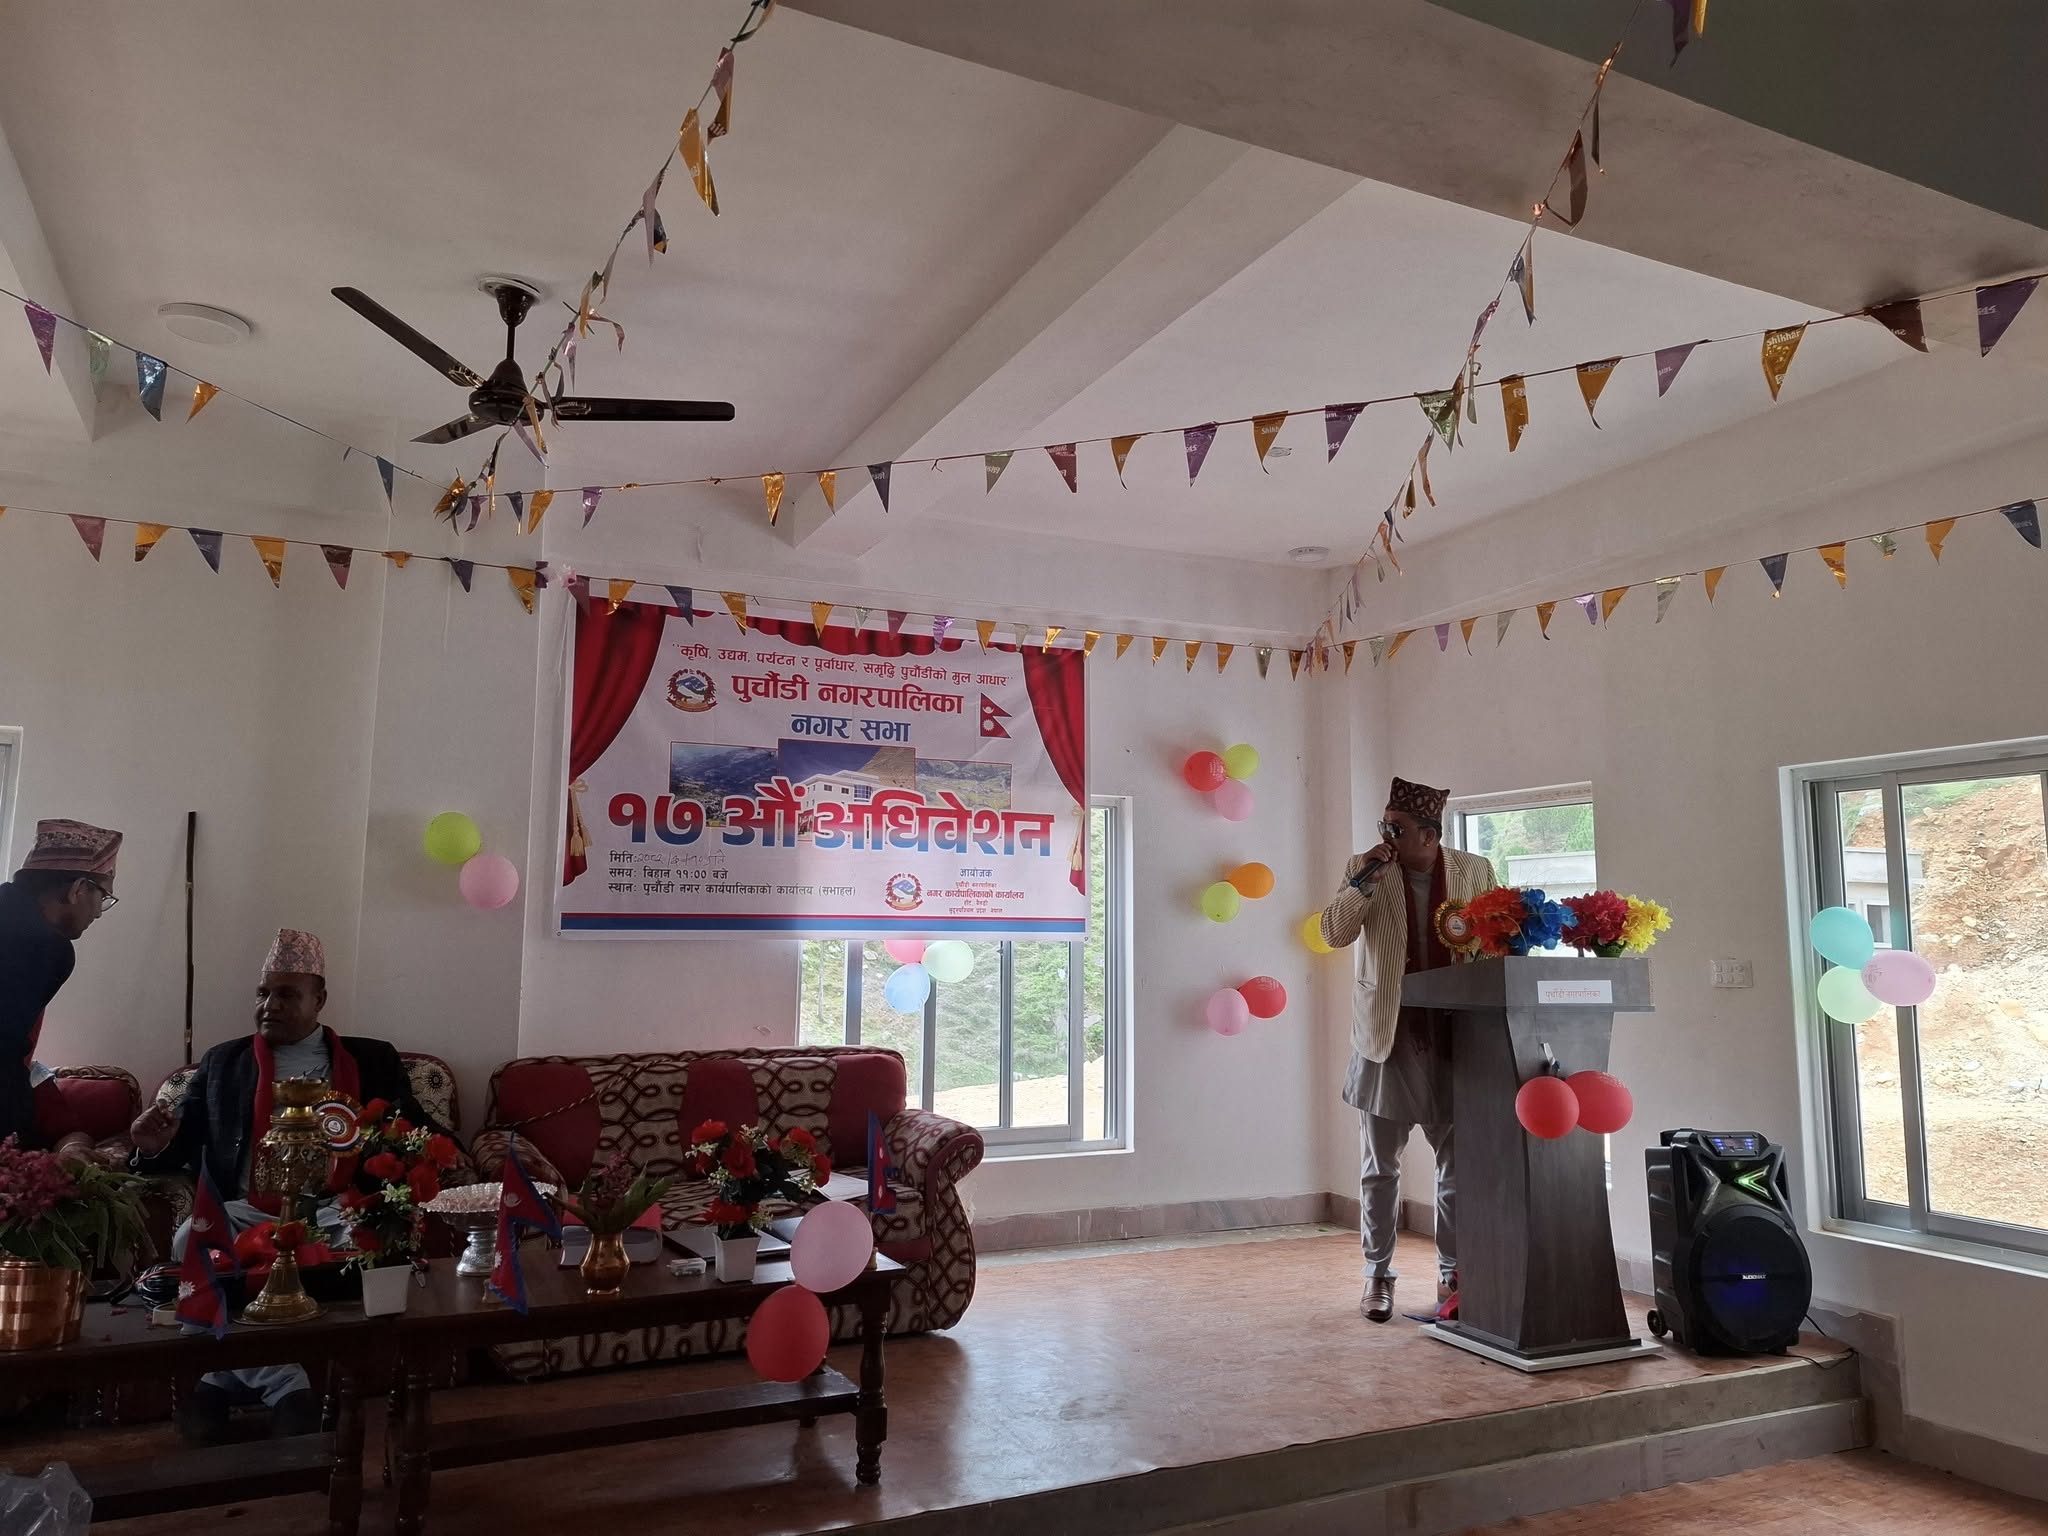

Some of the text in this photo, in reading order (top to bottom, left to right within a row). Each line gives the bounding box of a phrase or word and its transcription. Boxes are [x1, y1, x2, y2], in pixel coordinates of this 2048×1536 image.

[756, 652, 796, 666] पर्यटन
[801, 656, 809, 668] र
[951, 671, 971, 685] मुल
[817, 682, 964, 714] नगरपालिका
[791, 714, 911, 742] नगर सभा
[608, 791, 705, 846] १७
[814, 789, 1055, 857] अधिवेशन
[680, 883, 701, 894] नगर
[776, 882, 814, 895] कार्यालय
